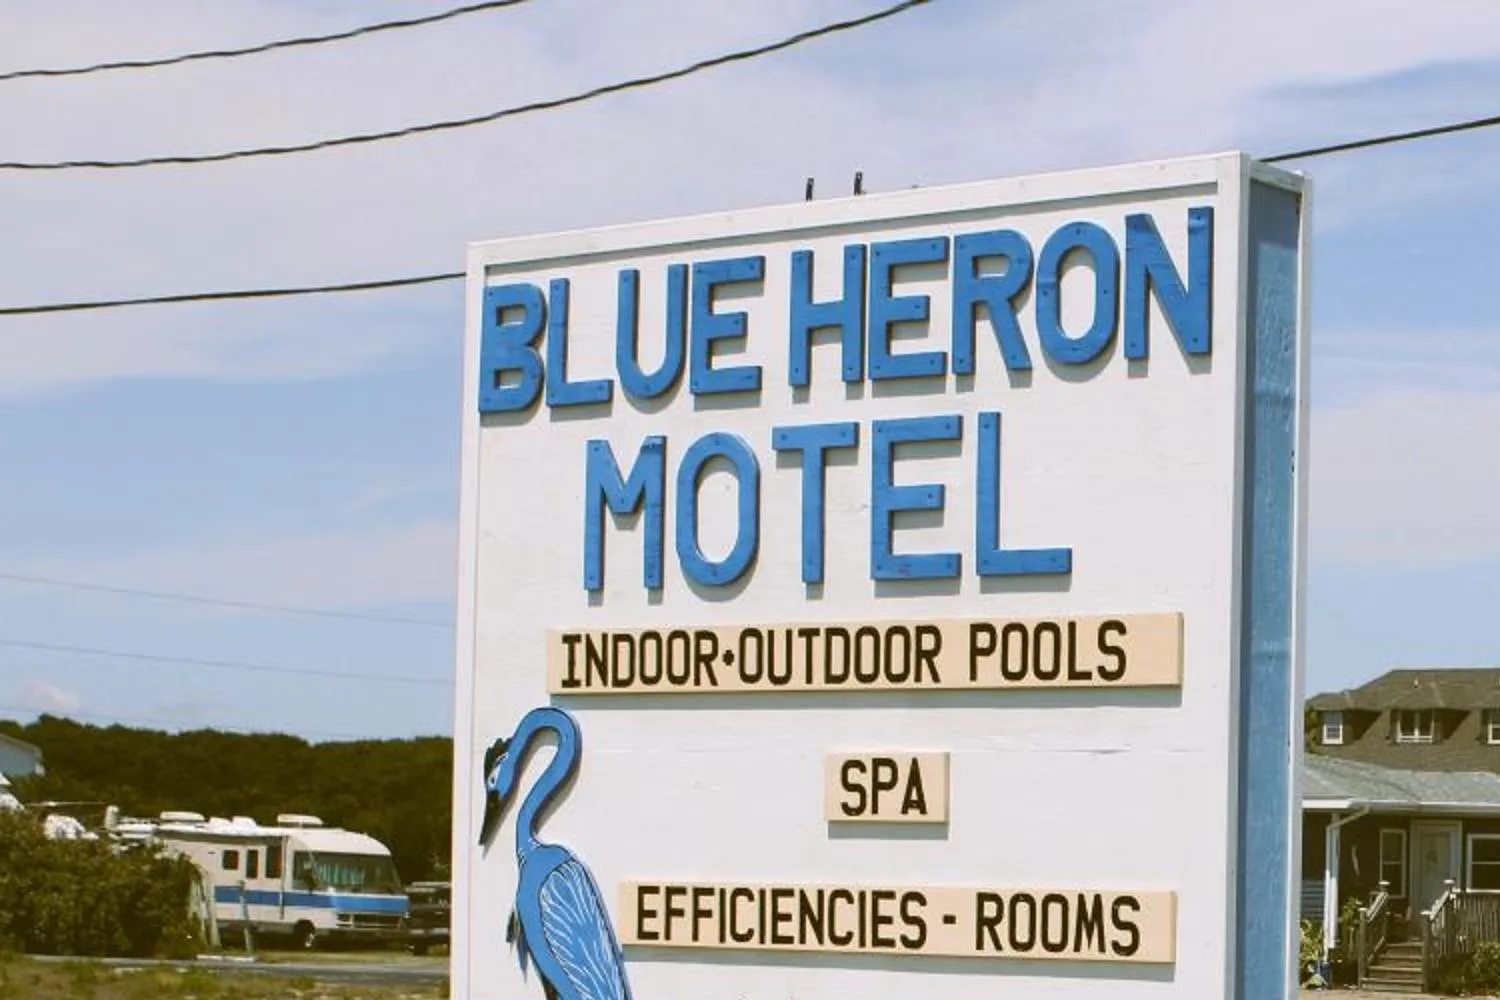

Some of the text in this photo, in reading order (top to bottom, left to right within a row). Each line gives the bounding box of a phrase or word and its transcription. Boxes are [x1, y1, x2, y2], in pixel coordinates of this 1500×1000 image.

[478, 206, 1214, 414] BLUE HERON
[583, 411, 1072, 592] MOTEL
[969, 619, 1127, 682] POOLS
[841, 757, 928, 817] SPA
[637, 885, 927, 950] EFFICIENCIES
[975, 892, 1141, 957] ROOMS
